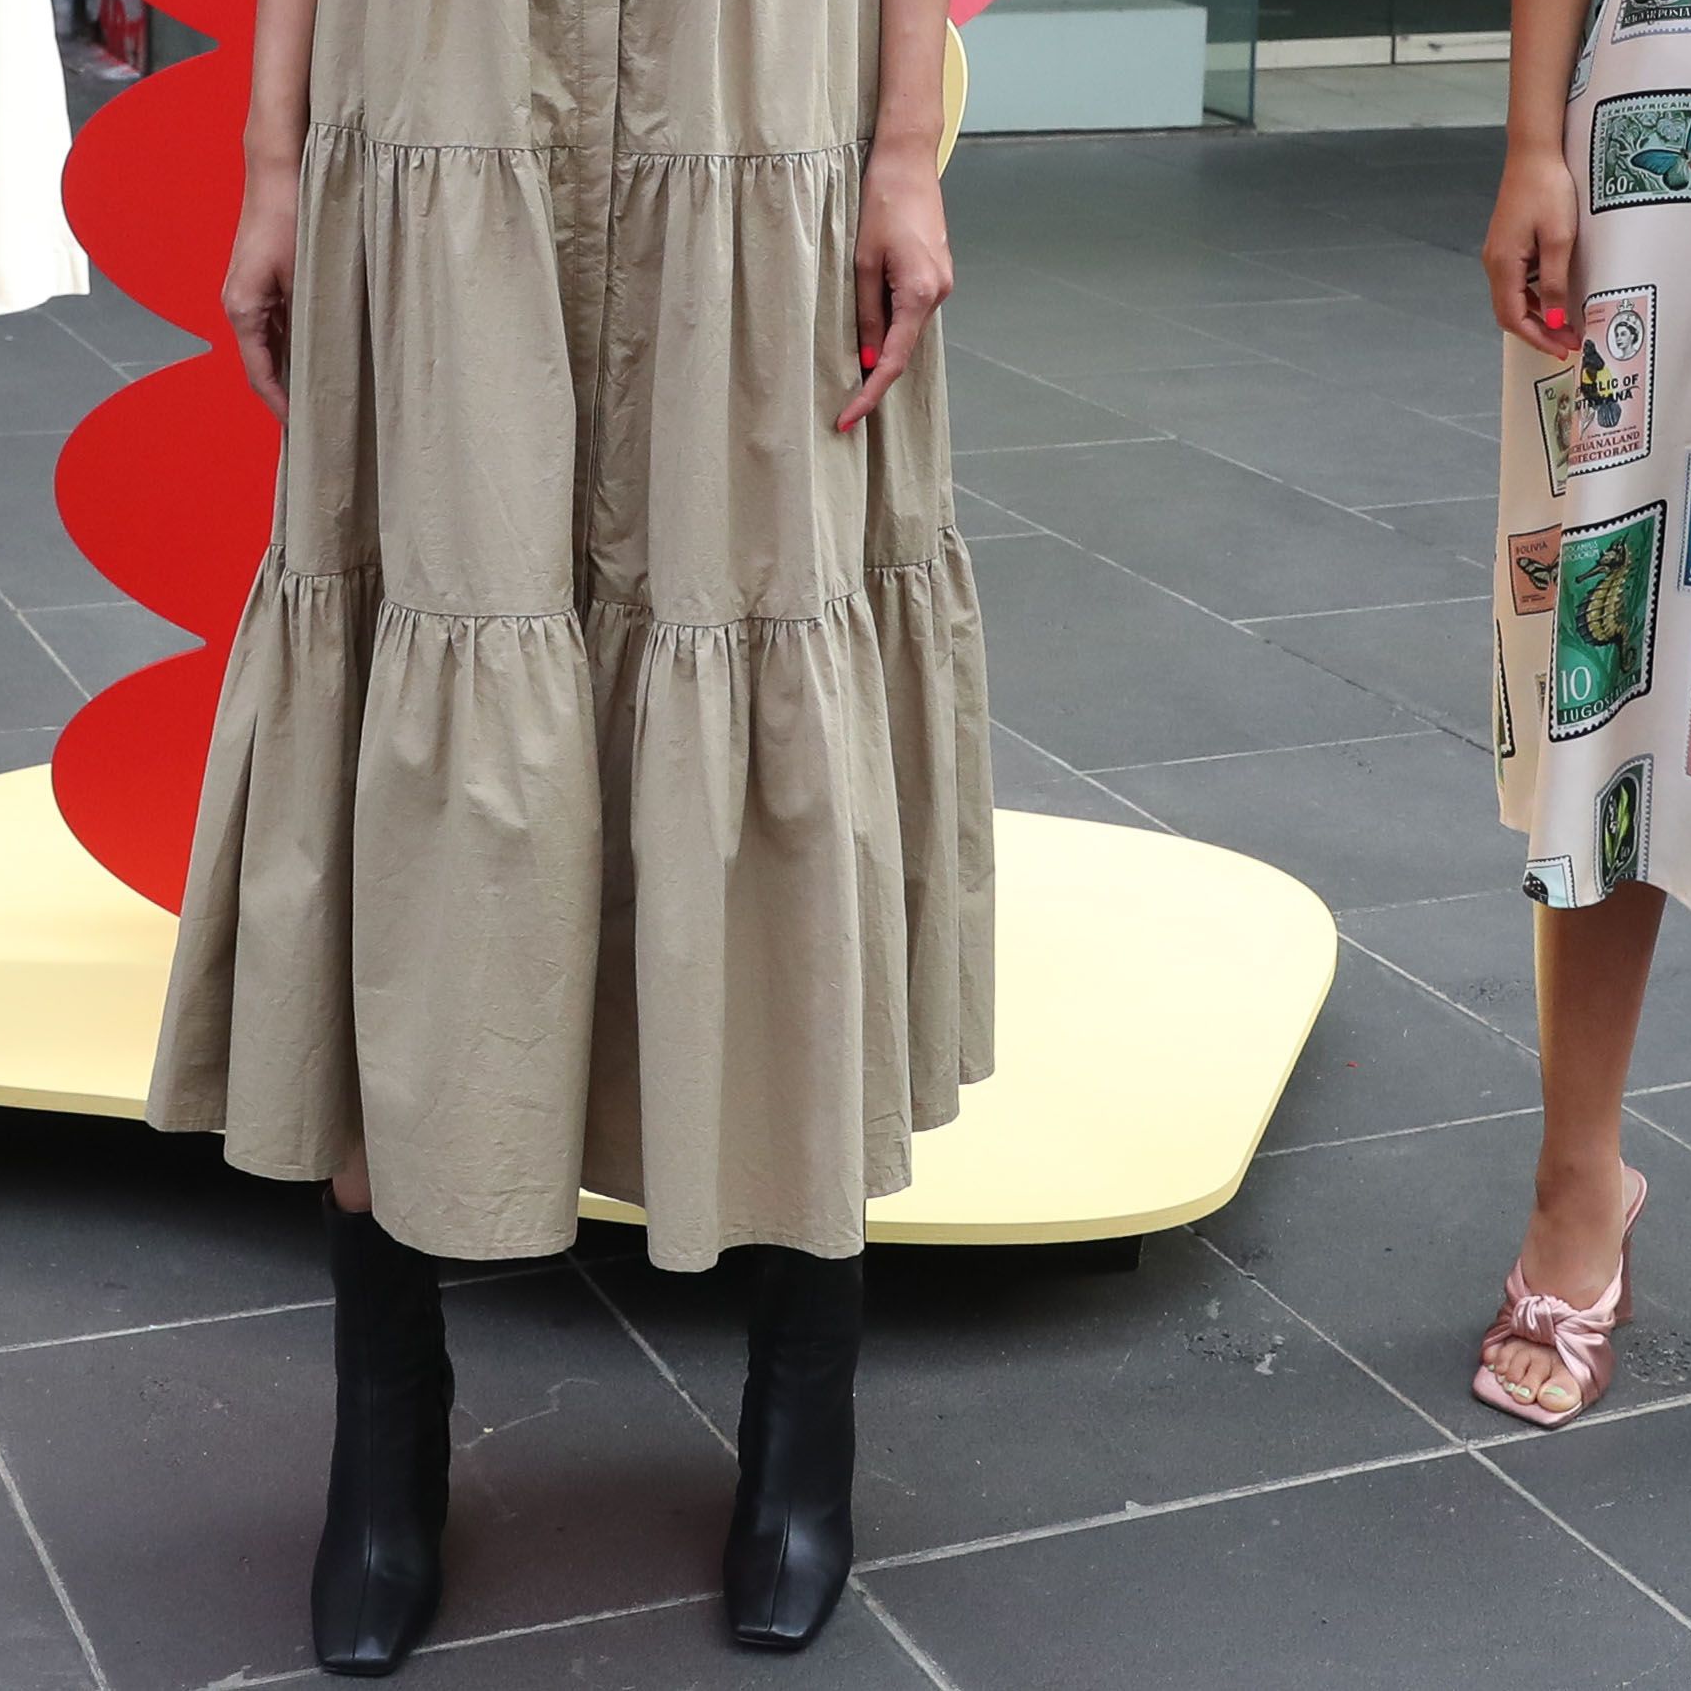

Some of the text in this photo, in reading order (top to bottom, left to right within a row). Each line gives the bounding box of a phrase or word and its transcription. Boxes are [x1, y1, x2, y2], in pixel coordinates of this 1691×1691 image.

[1658, 6, 1691, 20] POSTA
[1622, 374, 1640, 387] OF
[1515, 540, 1548, 555] BOLIVIA
[1560, 665, 1592, 704] 10
